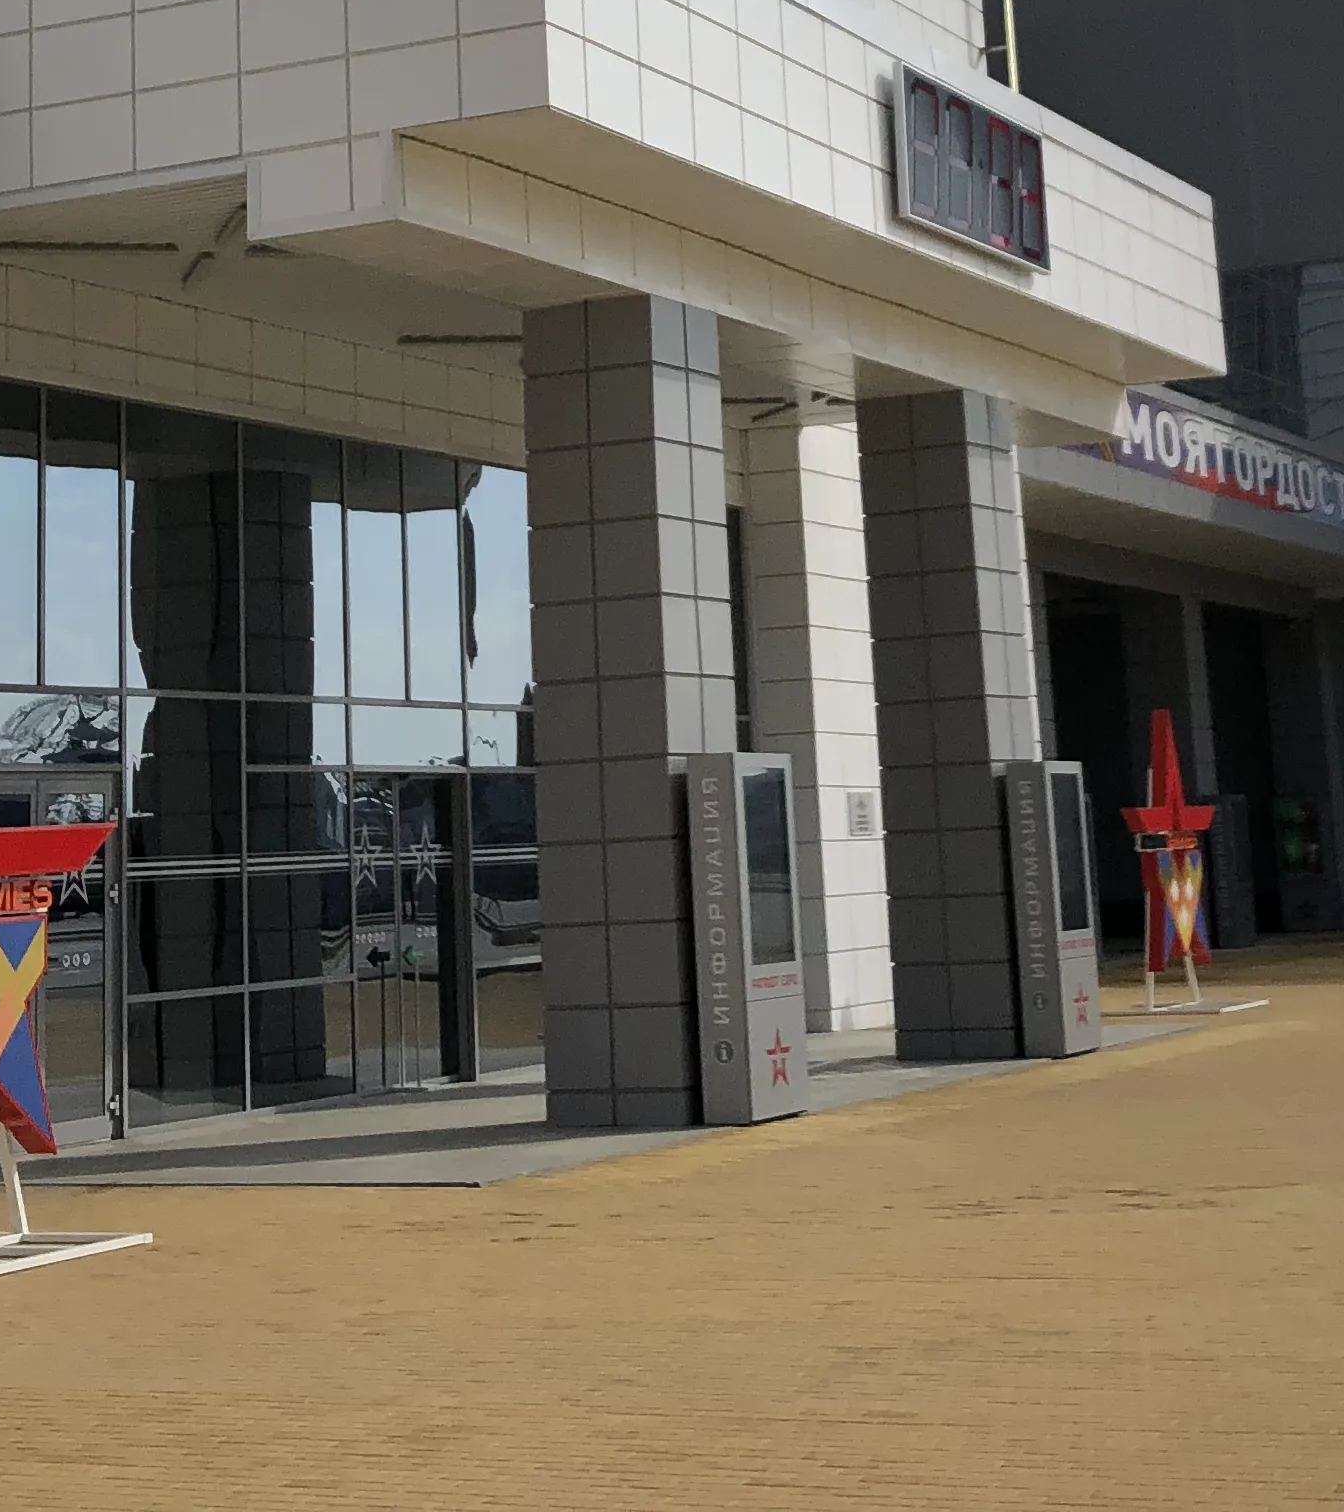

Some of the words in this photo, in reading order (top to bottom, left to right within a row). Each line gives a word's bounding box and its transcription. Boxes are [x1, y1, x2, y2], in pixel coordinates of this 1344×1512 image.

[1122, 403, 1208, 477] МОЯ
[701, 776, 731, 1026] ИНФОРМАЦИЯ
[1018, 780, 1046, 979] ИНФОРМАЦИЯ
